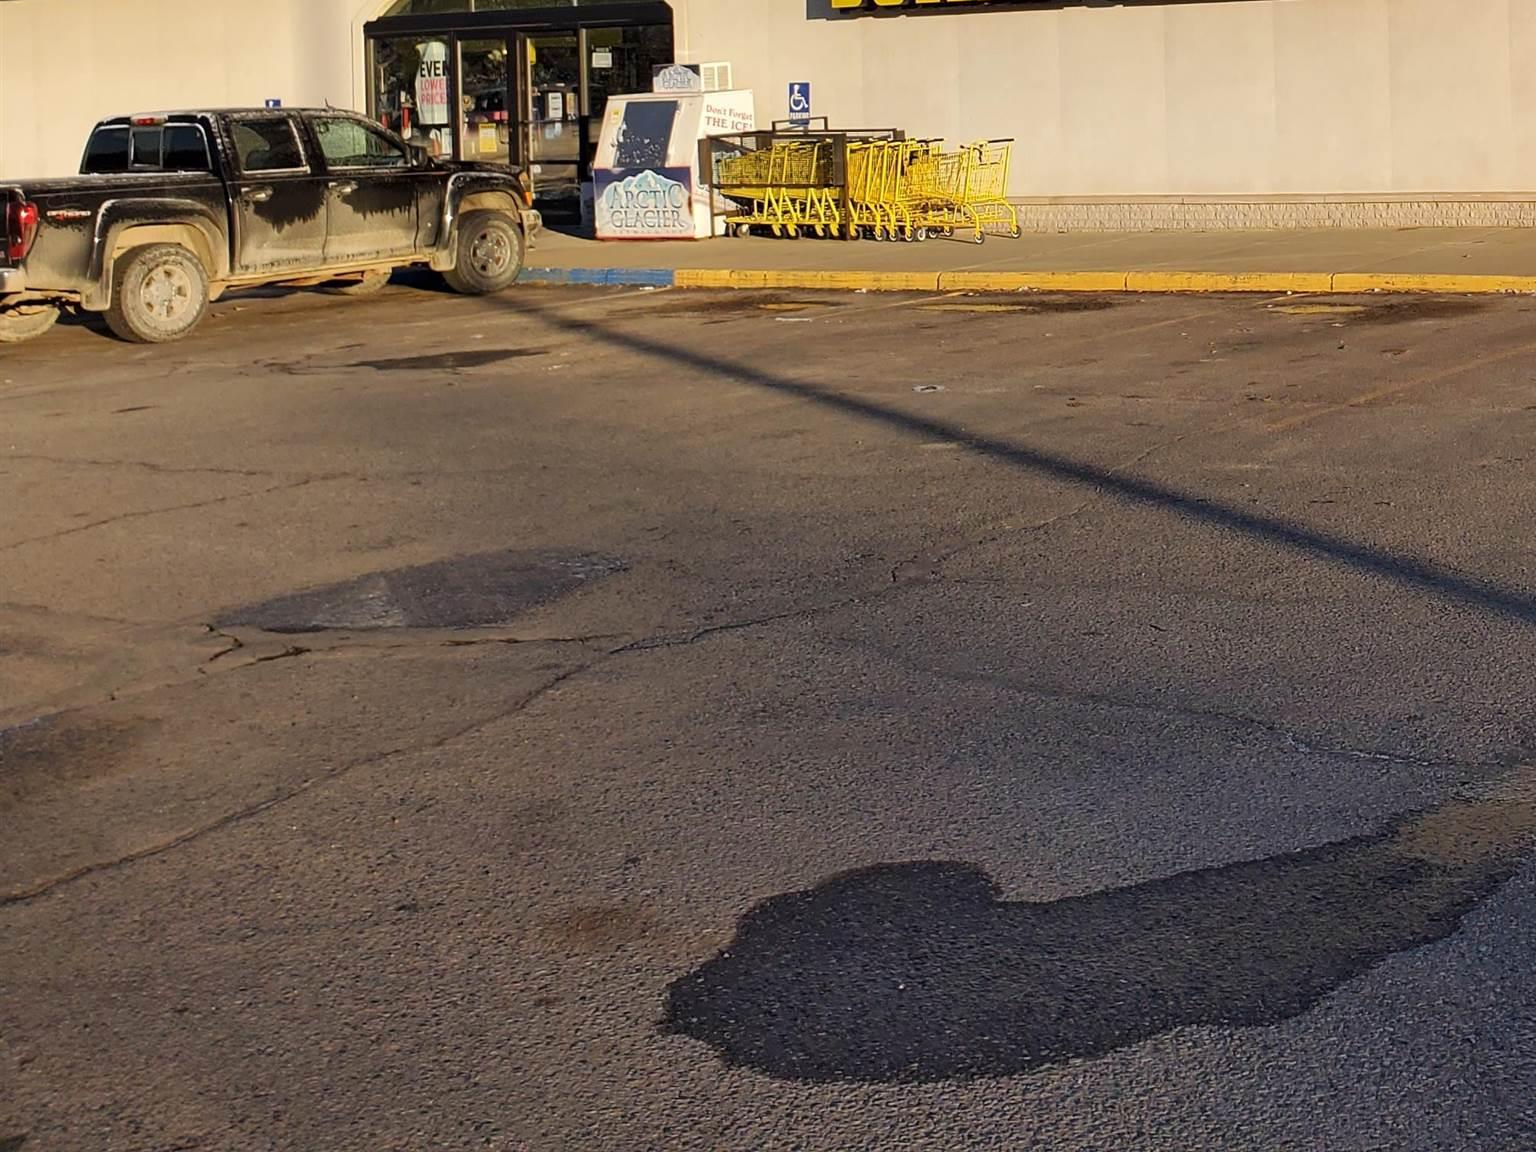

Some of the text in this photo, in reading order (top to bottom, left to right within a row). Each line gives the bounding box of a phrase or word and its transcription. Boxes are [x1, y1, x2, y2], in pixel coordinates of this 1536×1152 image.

[706, 105, 752, 121] Don't Forget
[705, 116, 728, 128] THE
[610, 184, 683, 208] ARCTIC
[611, 210, 685, 228] GLACIER
